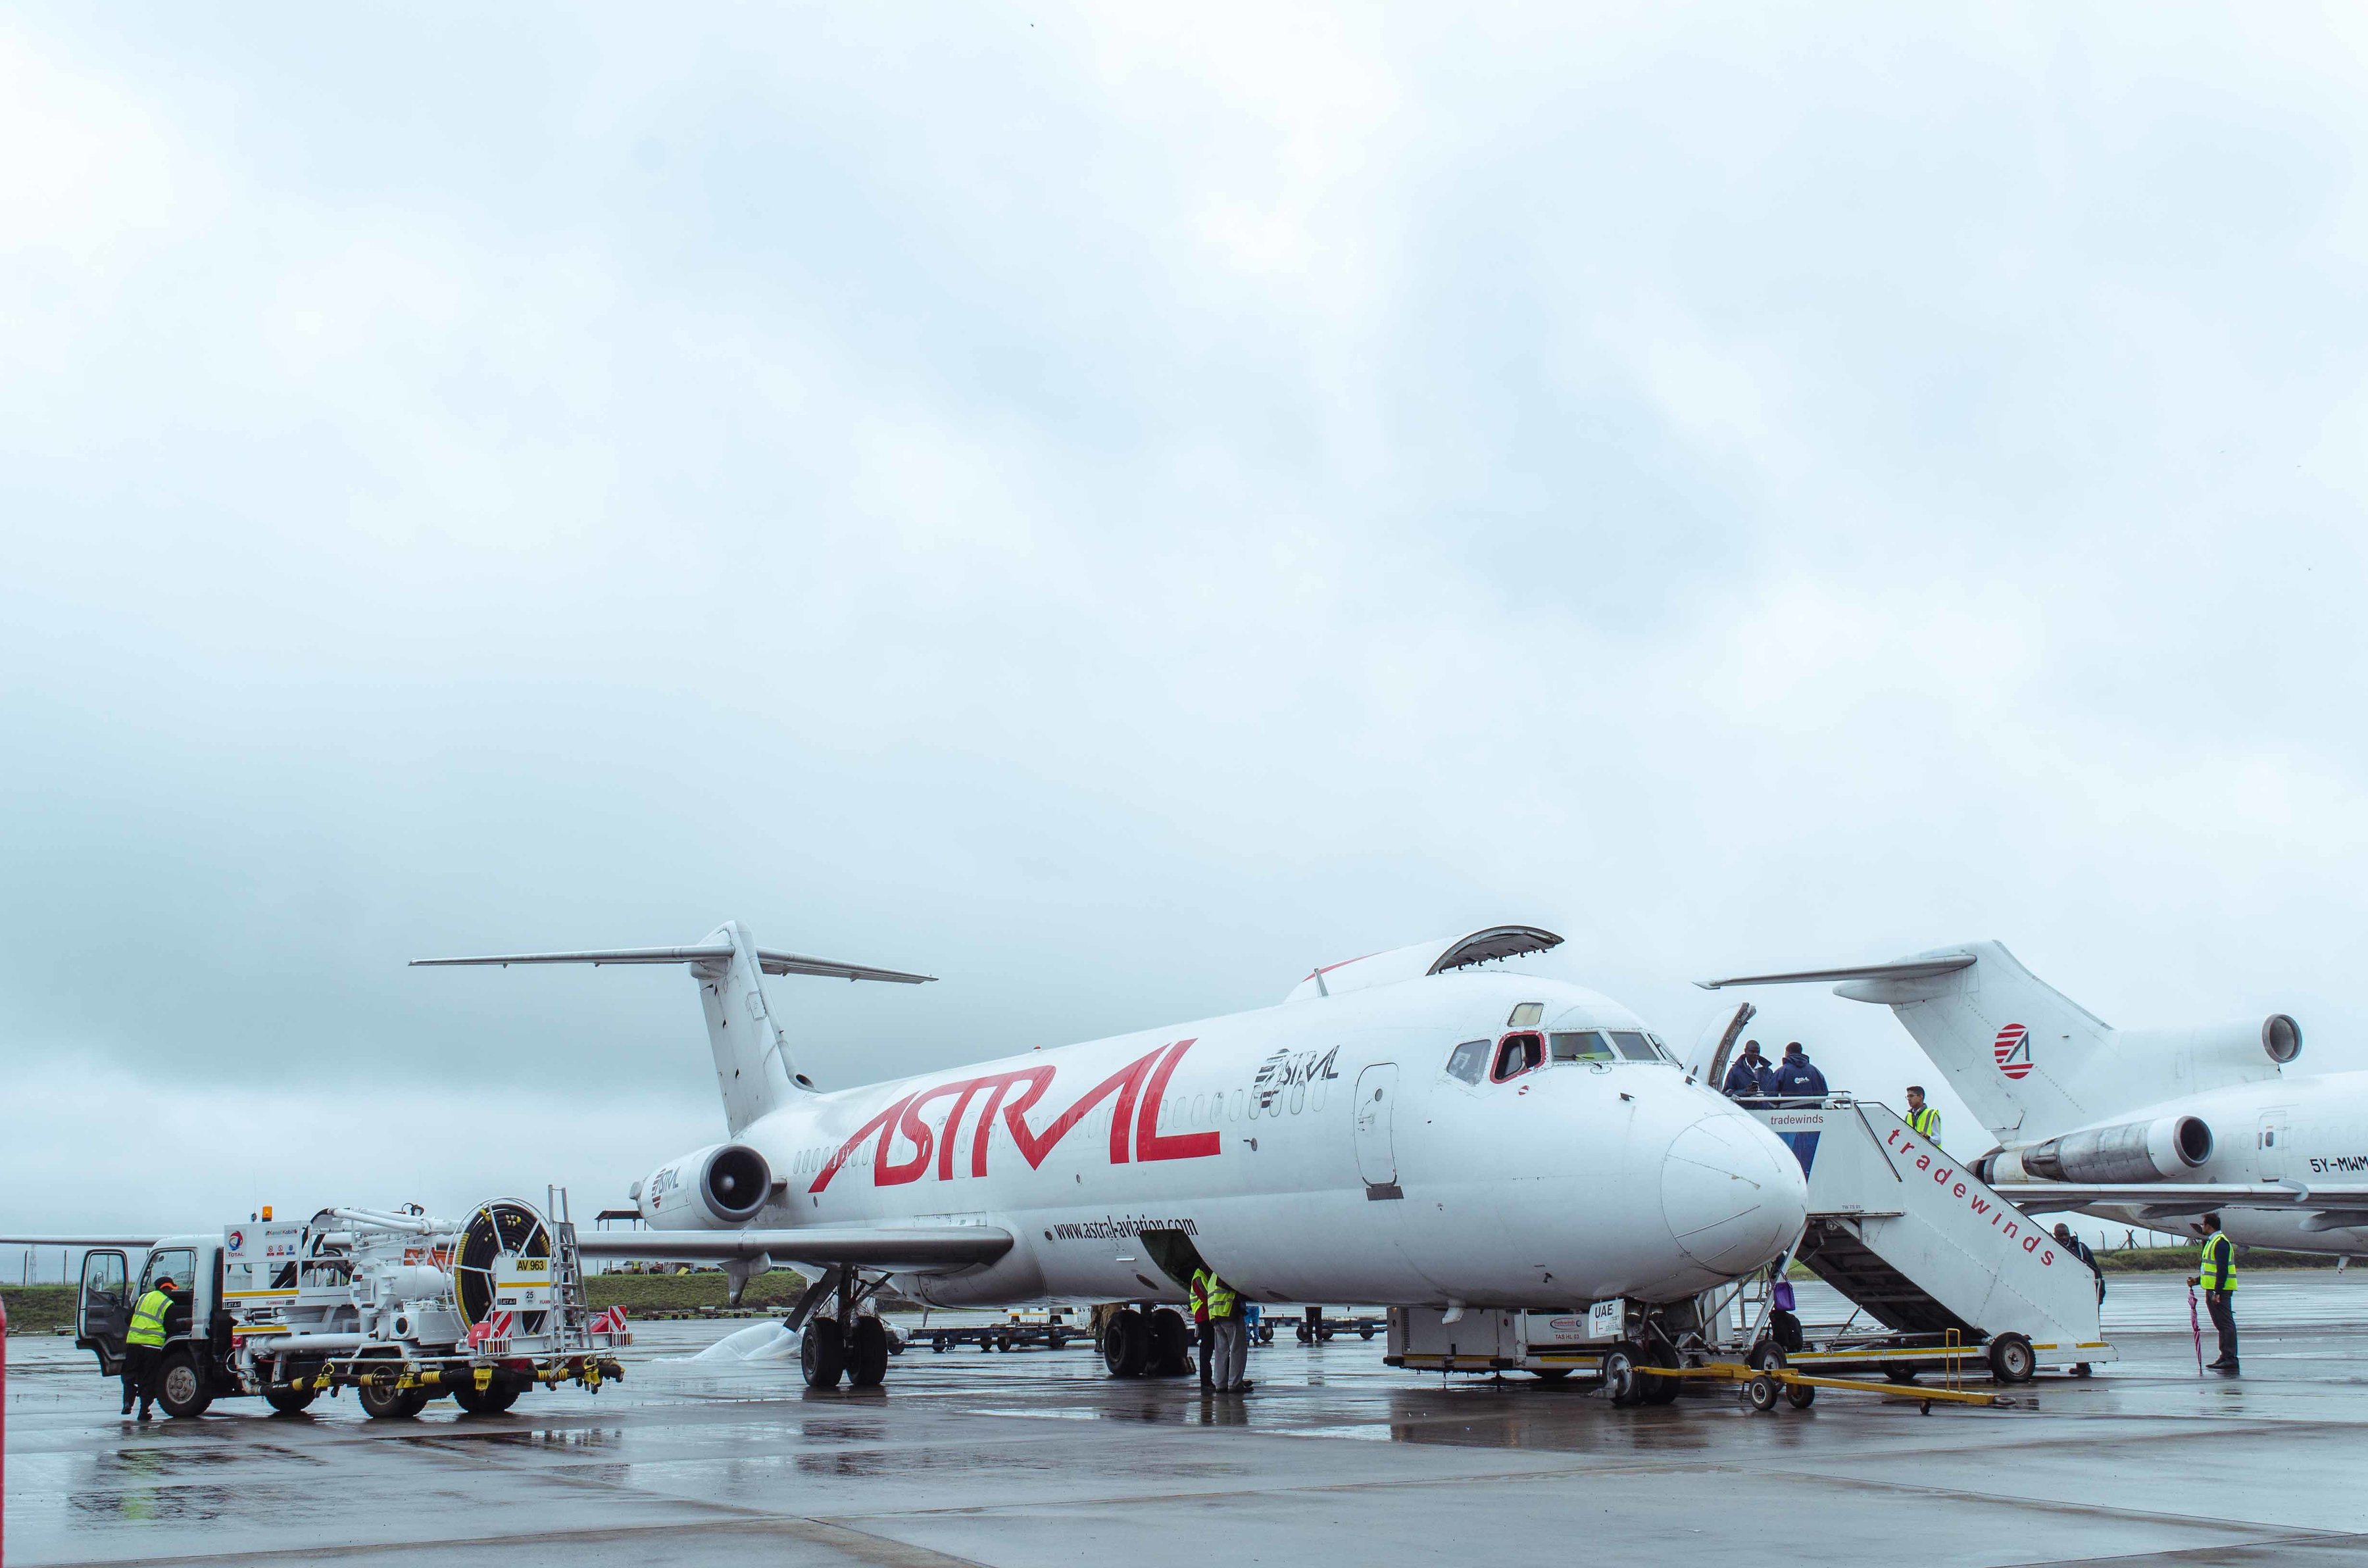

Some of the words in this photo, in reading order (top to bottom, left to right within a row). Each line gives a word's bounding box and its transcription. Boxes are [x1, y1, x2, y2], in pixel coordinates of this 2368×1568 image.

[808, 1038, 1221, 1194] ASTRAL
[1771, 1115, 1823, 1125] tradewinds
[1887, 1128, 2055, 1266] tradewinds
[516, 1261, 528, 1271] AV
[530, 1260, 544, 1270] 963
[1594, 1303, 1613, 1319] UAE
